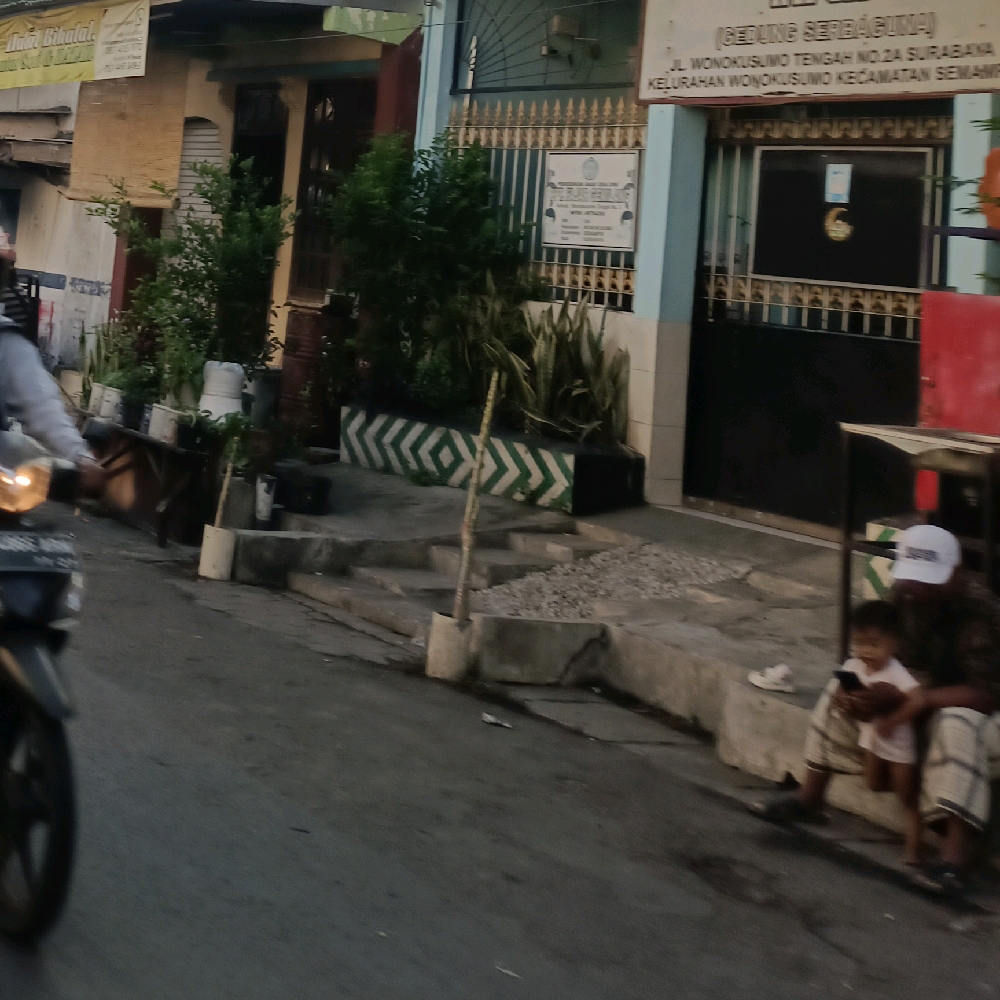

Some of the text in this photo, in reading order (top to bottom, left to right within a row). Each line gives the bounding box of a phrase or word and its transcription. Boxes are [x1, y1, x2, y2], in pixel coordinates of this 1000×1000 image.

[690, 53, 790, 70] WONOKUSUMO
[794, 50, 853, 66] TENGAH
[648, 76, 726, 90] KELURAHAN
[729, 72, 832, 88] WONOKUSUMO
[835, 67, 932, 84] KECAMATAN
